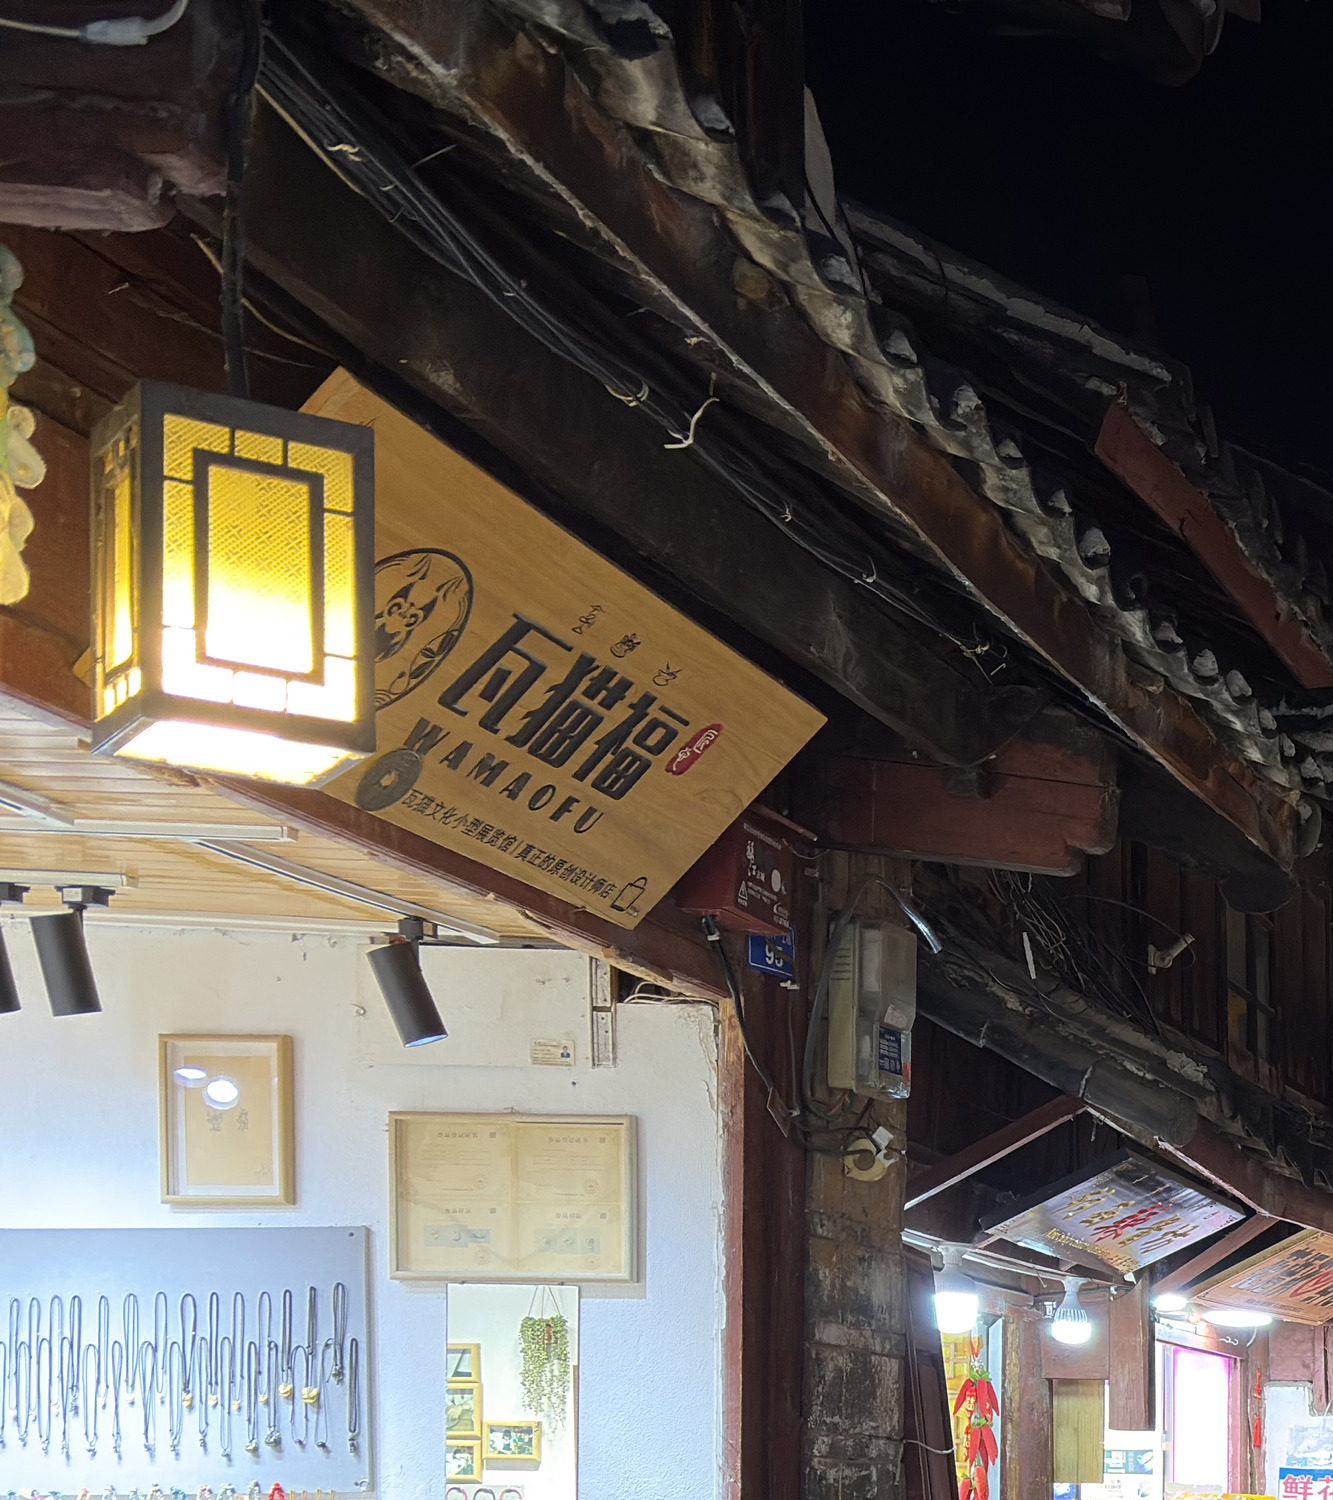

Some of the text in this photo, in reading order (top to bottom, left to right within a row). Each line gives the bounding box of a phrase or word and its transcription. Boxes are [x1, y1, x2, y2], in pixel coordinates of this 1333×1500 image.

[403, 717, 605, 833] WAMAOFU
[438, 612, 690, 800] 瓦猫福
